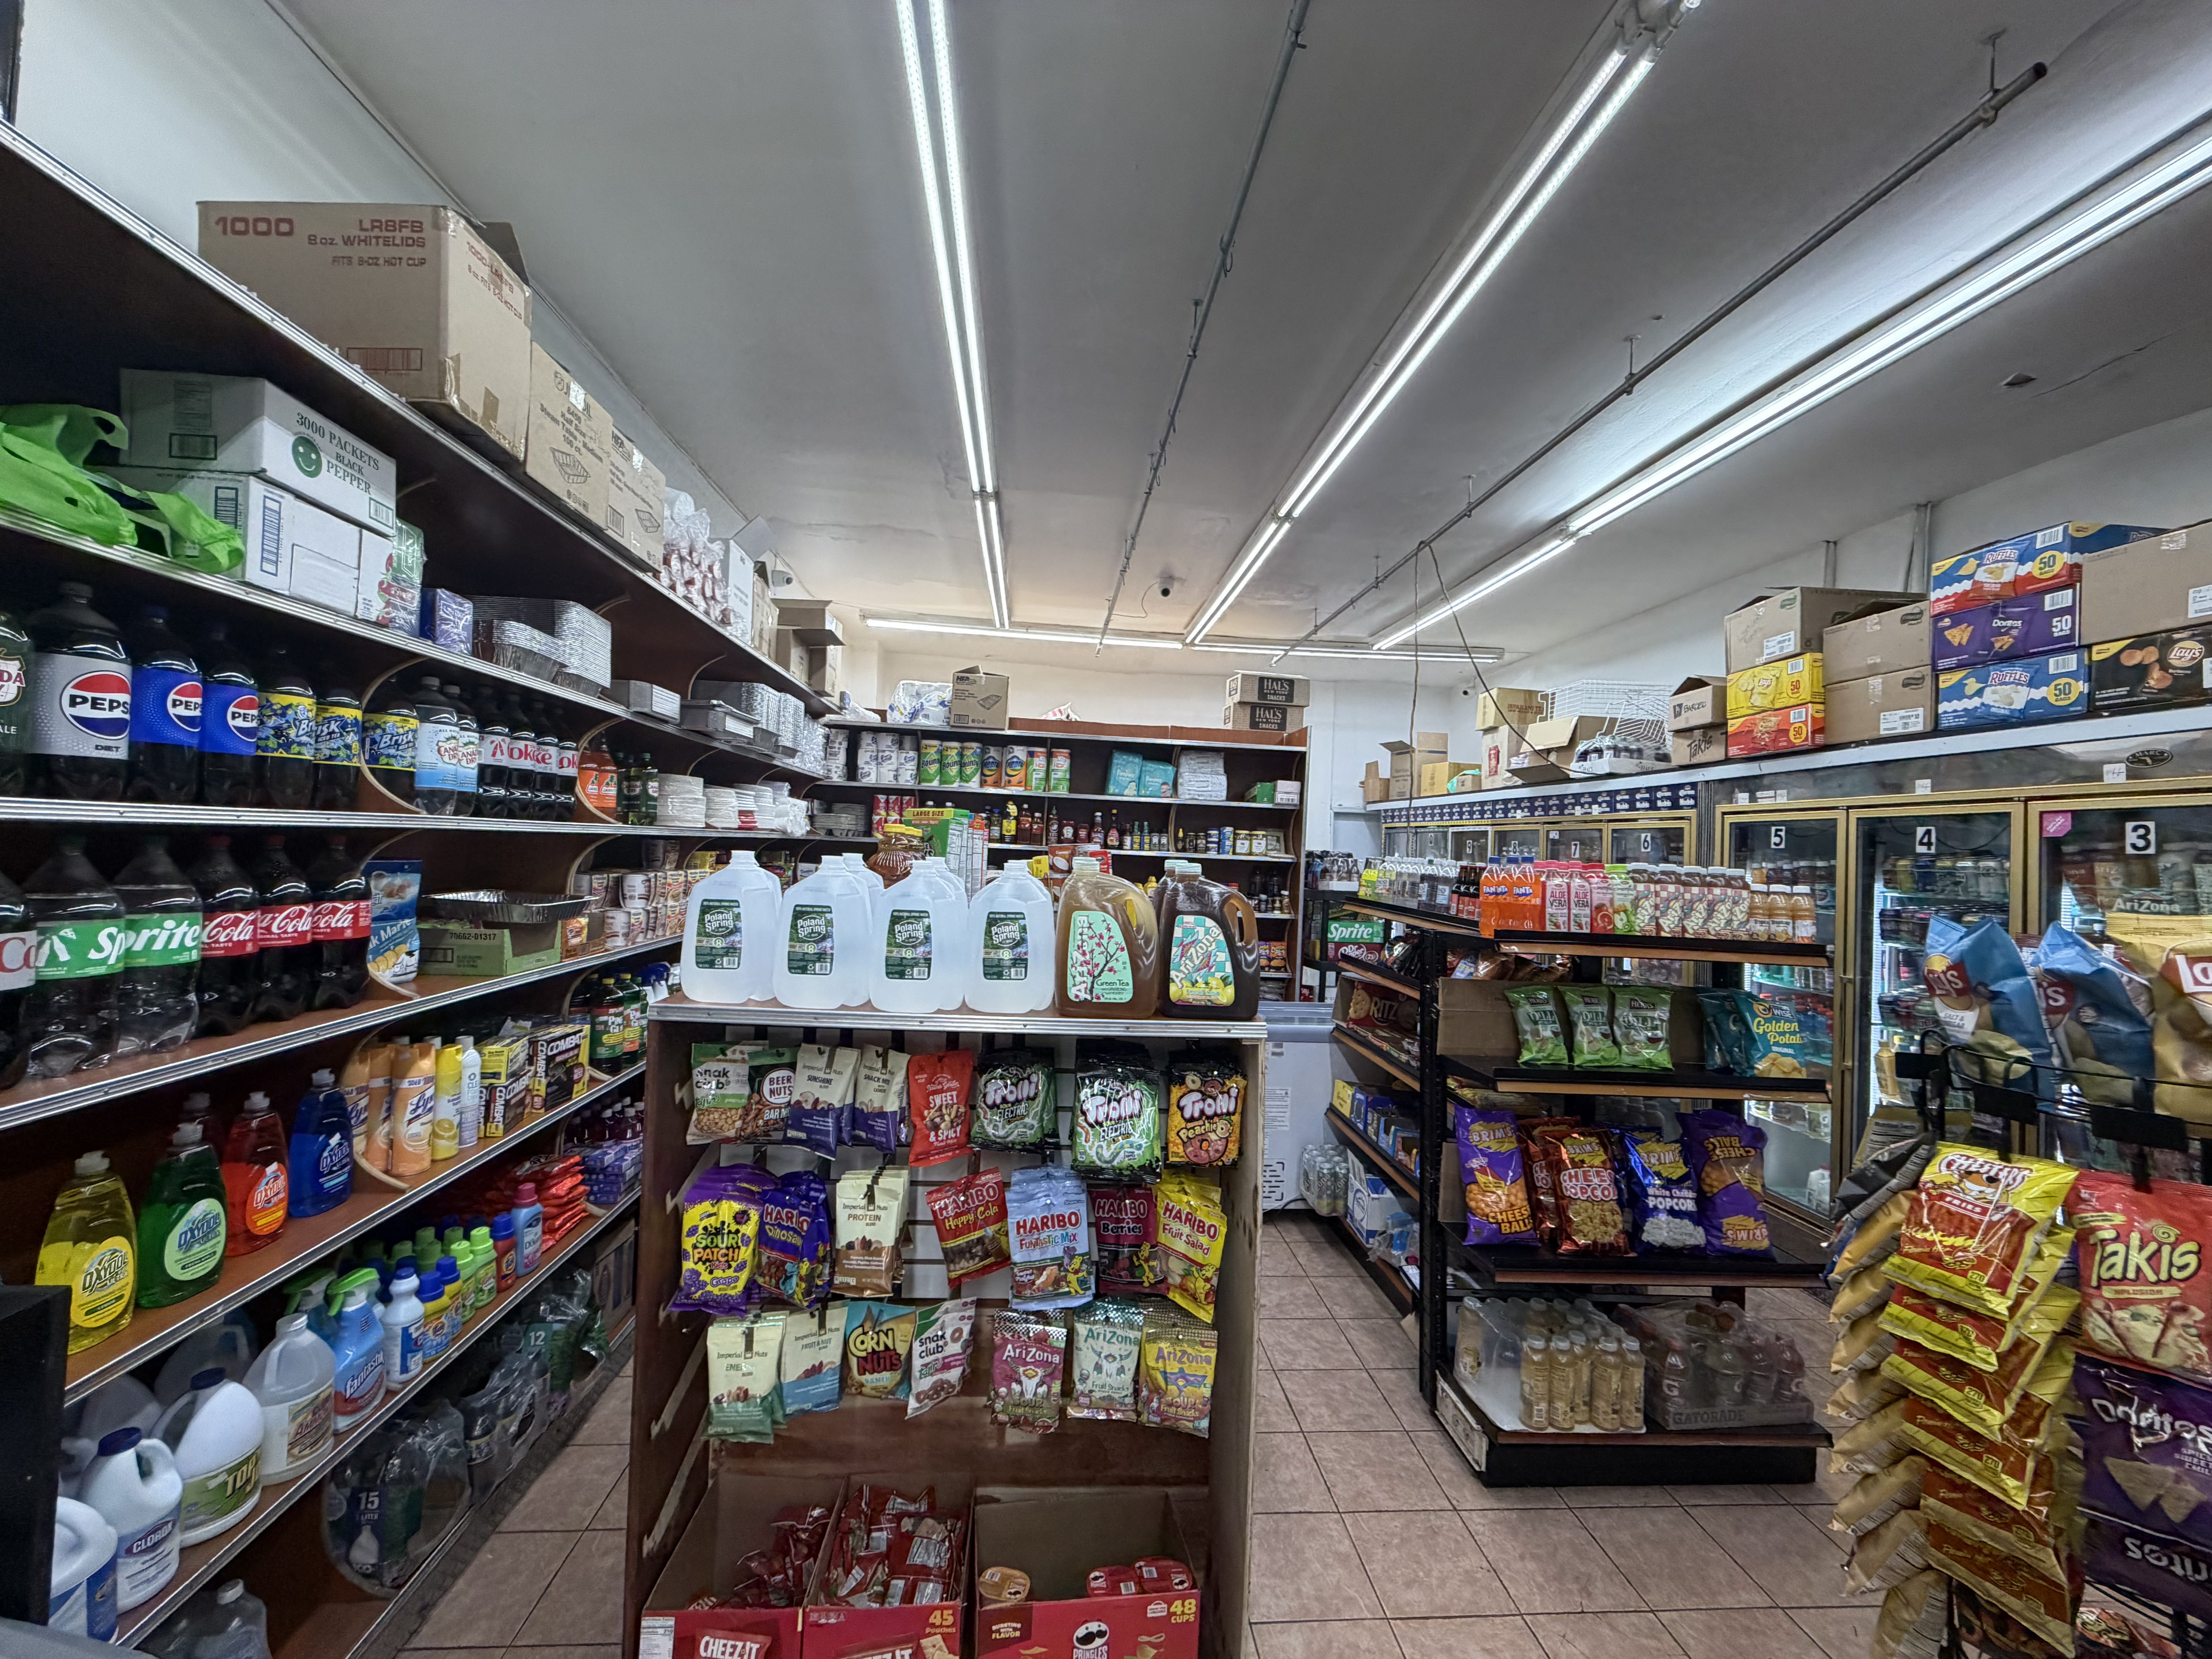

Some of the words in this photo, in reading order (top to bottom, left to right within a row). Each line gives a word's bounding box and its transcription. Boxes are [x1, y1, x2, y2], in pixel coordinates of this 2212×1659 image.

[214, 216, 295, 237] 1000
[342, 235, 426, 248] WHITELIDS
[331, 256, 352, 266] FITS
[383, 256, 403, 267] HOT
[407, 257, 426, 267] CUP
[540, 403, 560, 427] Steam
[296, 412, 325, 439] 3000
[328, 429, 380, 471] PACKETS
[335, 451, 364, 476] BLACK
[326, 459, 372, 496] PEPPER
[2038, 554, 2057, 571] 50
[2052, 615, 2072, 632] 50
[1264, 678, 1290, 691] HAL'S
[1791, 680, 1801, 691] 50
[2053, 682, 2072, 697] 50
[69, 694, 130, 715] PEPS
[1256, 707, 1282, 719] HAL'S
[1792, 726, 1803, 737] 50
[1643, 835, 1649, 850] 6
[1772, 829, 1784, 847] 5
[1917, 830, 1934, 851] 4
[2130, 824, 2151, 851] 3
[1467, 842, 1472, 852] 9
[1513, 842, 1517, 854] 8
[1573, 843, 1578, 857] 7
[1549, 899, 1567, 908] VERA
[1574, 899, 1589, 908] VERA
[2113, 896, 2181, 913] AriZona
[704, 911, 733, 922] Poland
[797, 916, 826, 928] Poland
[705, 919, 734, 933] Spring
[798, 925, 826, 938] Spring
[895, 922, 923, 933] Poland
[991, 924, 1020, 935] Poland
[1328, 924, 1373, 941] Sprite
[895, 929, 924, 943] Spring
[993, 931, 1021, 945] Spring
[1170, 925, 1222, 989] AriZona
[1096, 979, 1117, 987] Green
[1117, 979, 1130, 987] Tea
[1369, 997, 1397, 1020] RITZ
[1772, 1007, 1793, 1018] WISE
[1753, 1018, 1800, 1033] Golden
[547, 1032, 585, 1056] COMBAT
[696, 1068, 730, 1079] snak
[769, 1075, 792, 1085] BEER
[806, 1074, 833, 1085] SUNSHINE
[769, 1086, 793, 1098] NUTS
[984, 1072, 1040, 1107] Trolli
[494, 1087, 505, 1125] COMBAT
[929, 1091, 958, 1108] SWEET
[1179, 1085, 1238, 1119] Trolli
[764, 1108, 779, 1120] BAR
[938, 1125, 962, 1141] SPICY
[1469, 1123, 1516, 1144] BRIM'S
[1567, 1141, 1602, 1156] BRIM'S
[253, 1173, 286, 1210] OXYDOL
[1647, 1187, 1670, 1197] White
[843, 1203, 866, 1211] Imperial
[937, 1182, 999, 1219] HARIBO
[1095, 1198, 1148, 1219] HARIBO
[1944, 1196, 1984, 1213] FRIES
[847, 1213, 882, 1222] PROTEIN
[944, 1211, 975, 1231] Happy
[976, 1204, 999, 1221] Cola
[1015, 1210, 1080, 1237] HARIBO
[1161, 1200, 1220, 1242] HARIBO
[177, 1212, 220, 1253] OXYDOL
[1100, 1220, 1144, 1237] Berries
[695, 1233, 739, 1248] SOUR
[1161, 1223, 1183, 1242] Fruit
[1183, 1235, 1212, 1258] Salad
[692, 1247, 740, 1263] PATCH
[2090, 1228, 2202, 1288] Takis
[81, 1250, 128, 1297] OXYDOL
[709, 1274, 740, 1288] Grape
[1969, 1272, 1985, 1282] 270
[529, 1331, 545, 1346] 12
[794, 1331, 817, 1342] Imperial
[827, 1325, 840, 1334] Nuts
[847, 1324, 895, 1358] CORN
[918, 1330, 947, 1347] snak
[1083, 1327, 1140, 1348] AriZona
[716, 1351, 742, 1359] Imperial
[918, 1343, 944, 1360] club
[1001, 1343, 1061, 1365] AriZona
[1155, 1346, 1212, 1366] AriZona
[856, 1352, 902, 1376] NUTS
[345, 1348, 385, 1398] fantastik
[1012, 1396, 1044, 1409] SOUR
[1965, 1388, 1985, 1401] 270
[1673, 1409, 1746, 1425] GATORADE
[359, 1491, 380, 1510] 15
[132, 1520, 174, 1554] CLOROX
[1170, 1599, 1196, 1615] 48
[929, 1609, 955, 1625] 45
[1171, 1614, 1195, 1623] CUPS
[992, 1630, 1020, 1639] FLAVOR
[1072, 1645, 1108, 1659] PRINGLES
